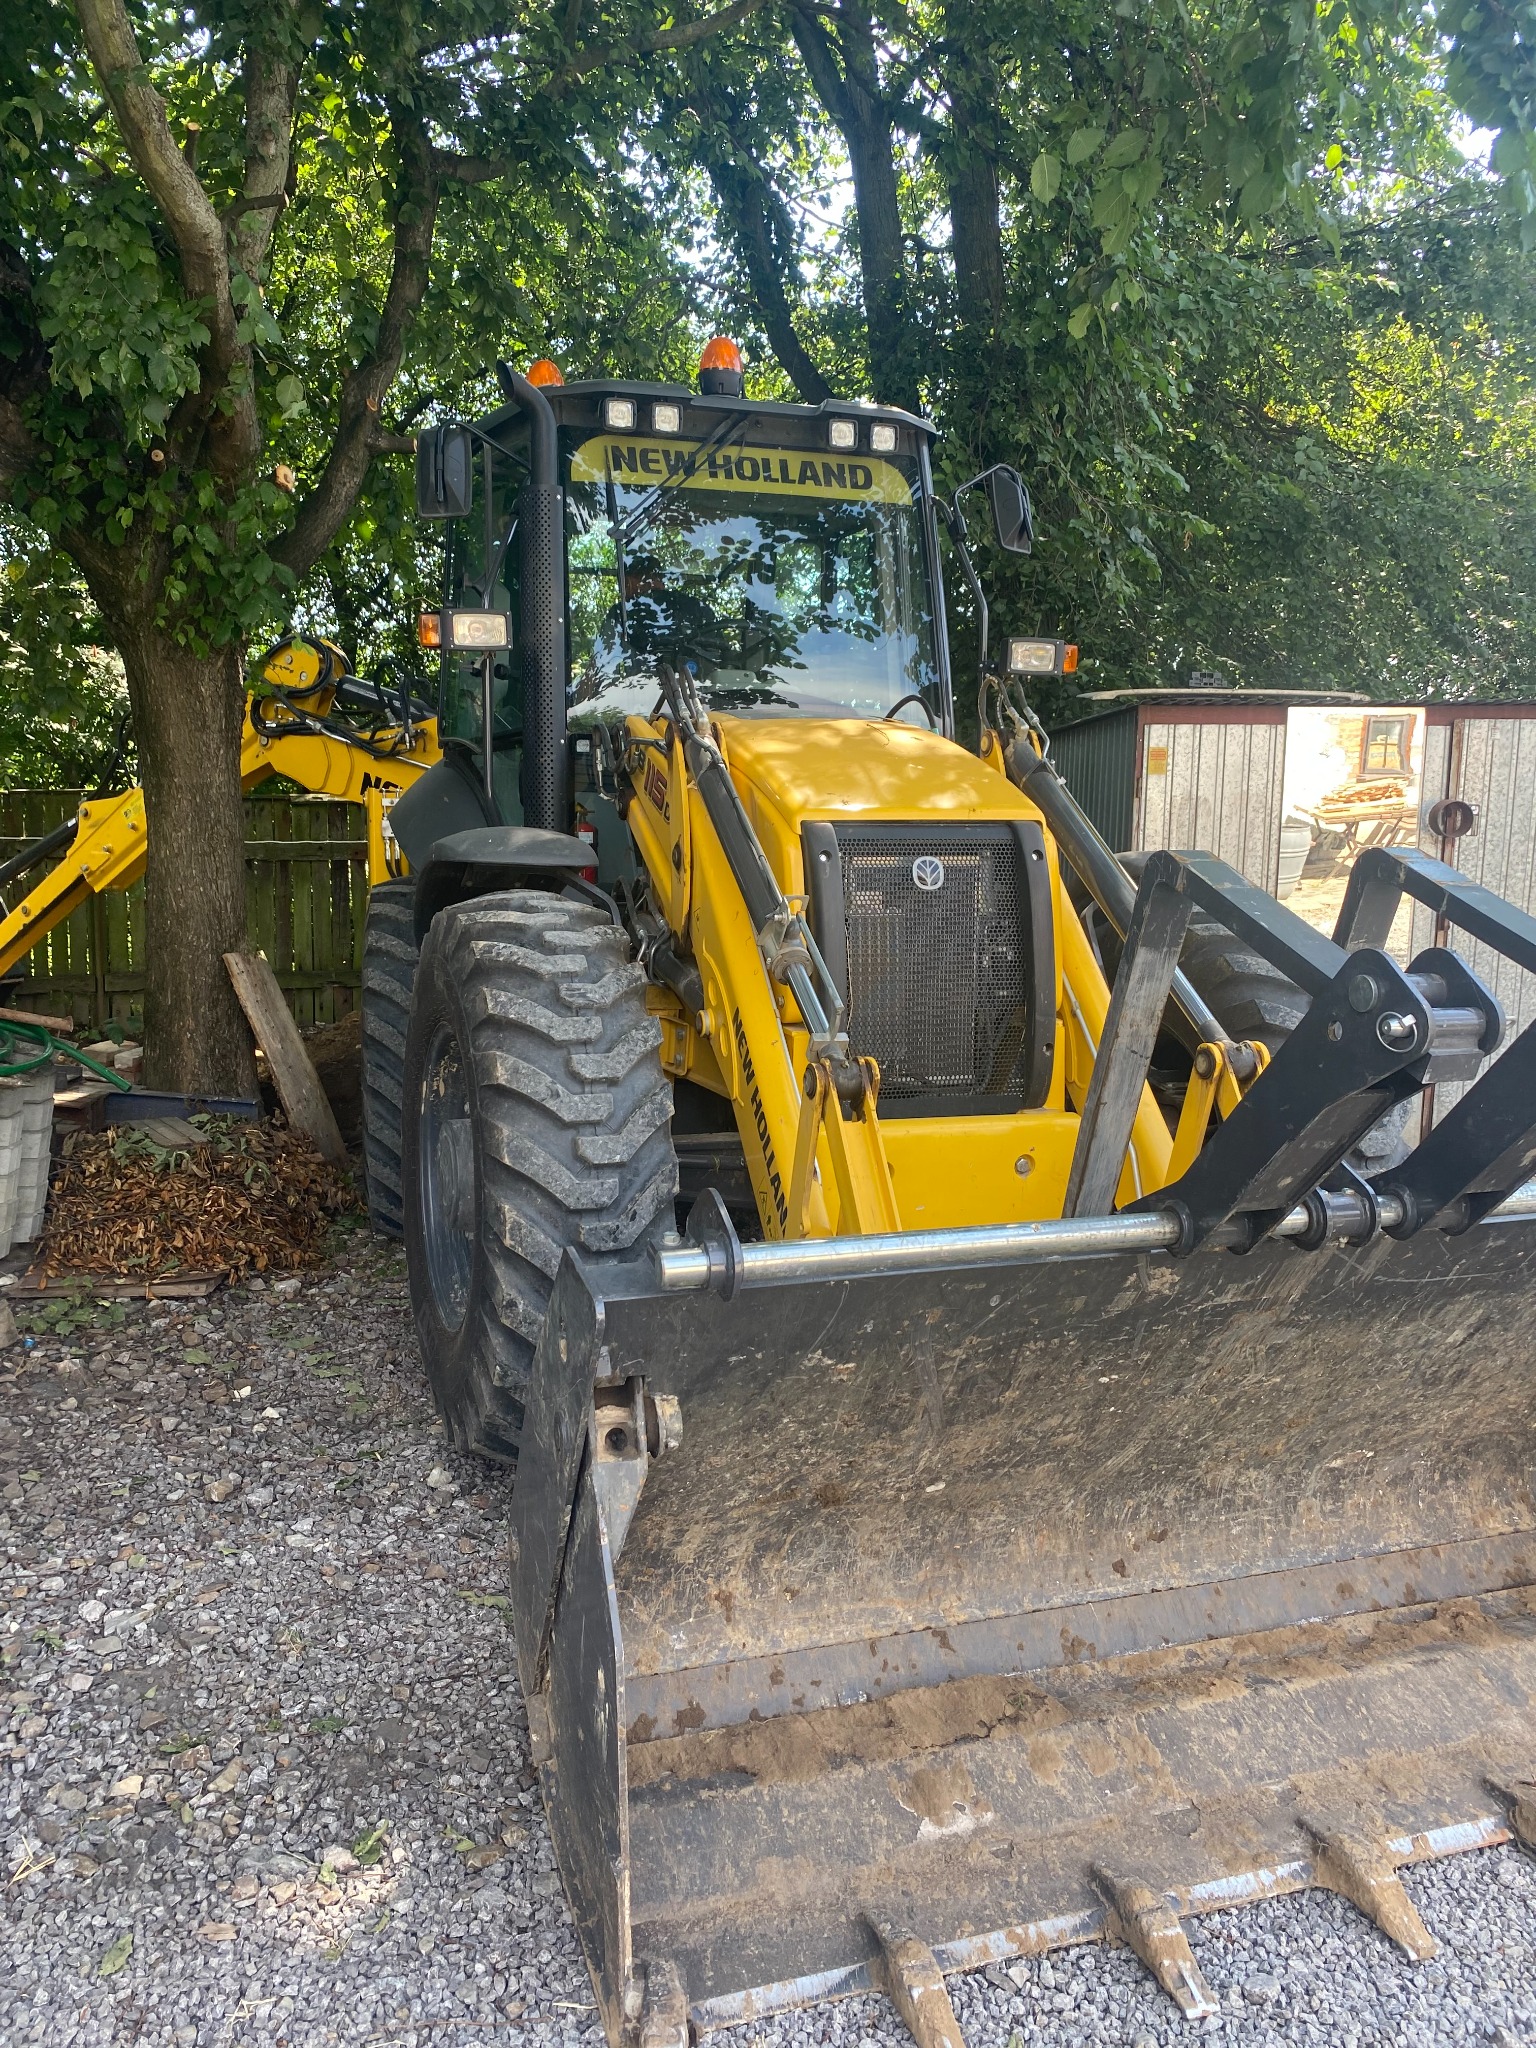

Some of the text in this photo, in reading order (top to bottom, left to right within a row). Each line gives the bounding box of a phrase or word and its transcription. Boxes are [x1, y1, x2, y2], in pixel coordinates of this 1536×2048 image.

[611, 445, 873, 490] NEW HOLLAND
[732, 1006, 788, 1238] NEW HOLLAN
